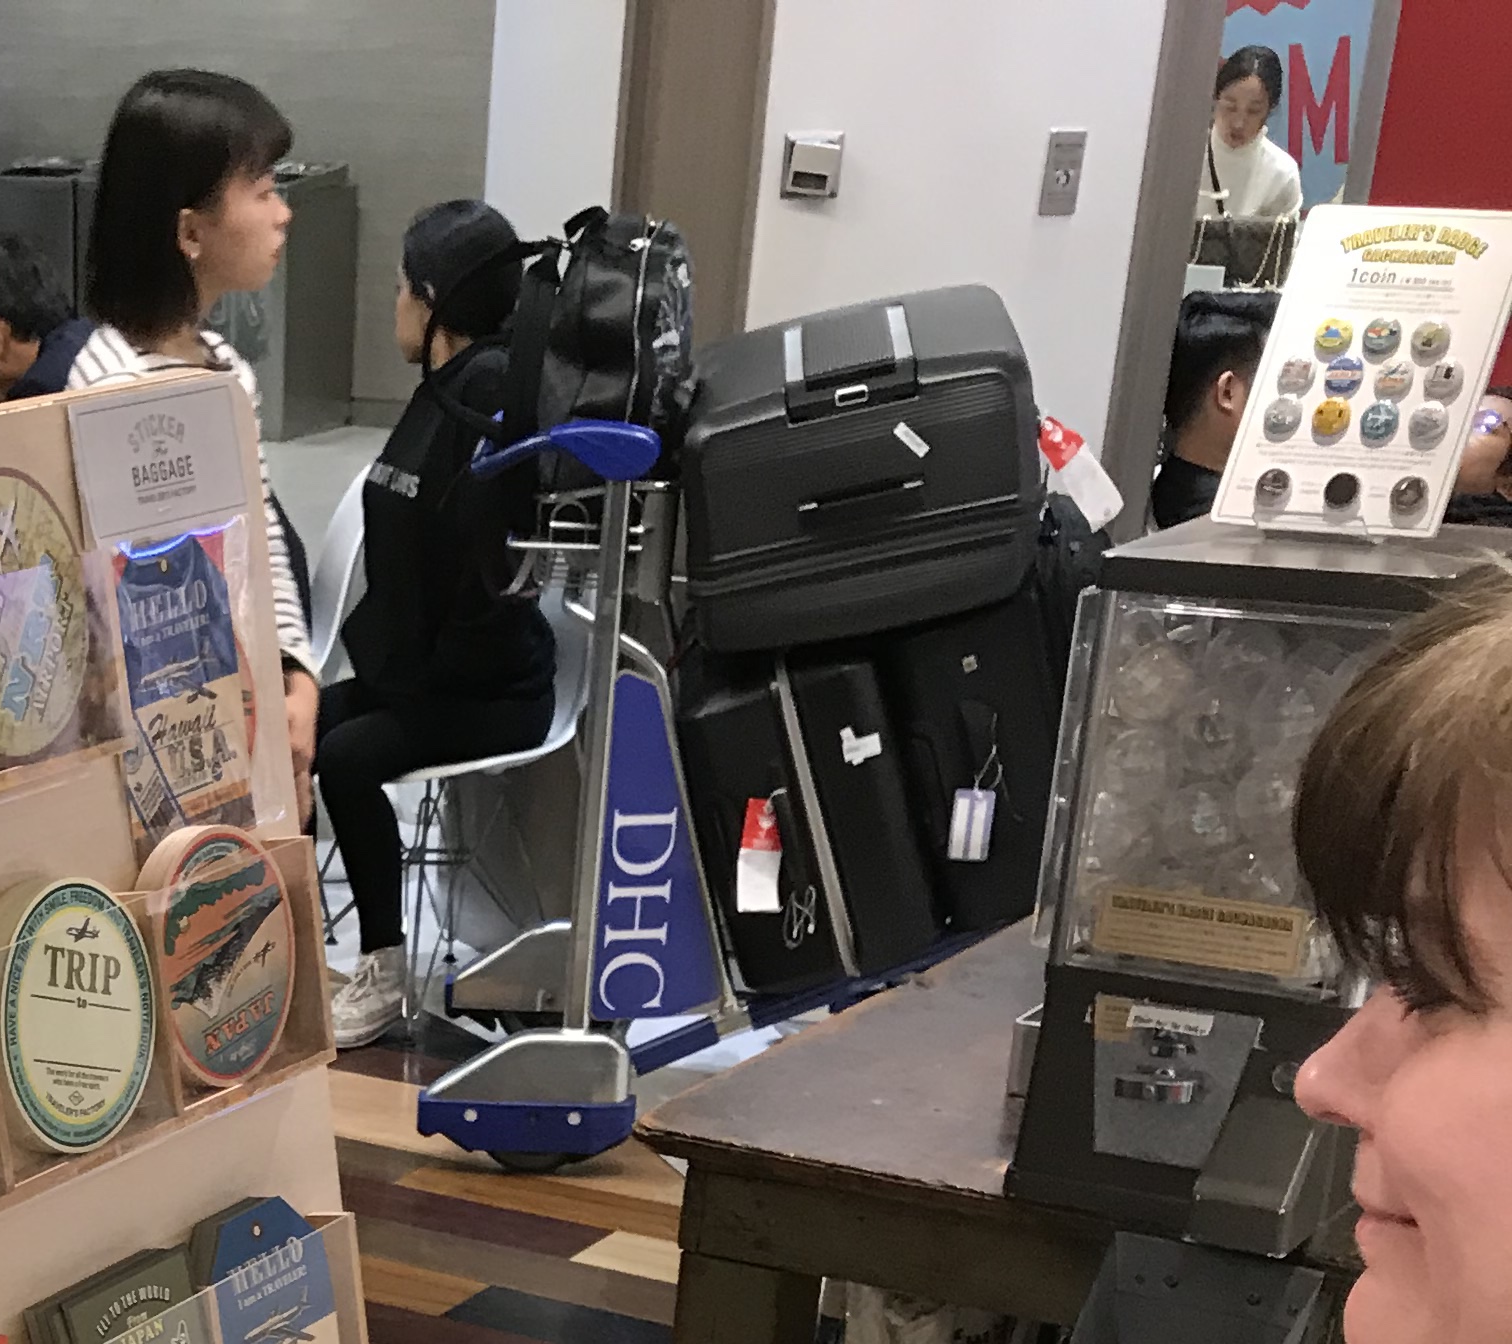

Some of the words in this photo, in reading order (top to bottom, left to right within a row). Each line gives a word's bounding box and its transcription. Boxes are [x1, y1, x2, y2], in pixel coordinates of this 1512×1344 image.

[1341, 223, 1437, 254] TRAVELER'S
[1351, 267, 1397, 284] 1coin
[131, 455, 195, 488] BAGGAGE
[597, 808, 678, 1015] DHC
[44, 943, 122, 996] TRIP
[227, 1236, 305, 1296] HELLO
[120, 1290, 138, 1311] THE
[138, 1285, 171, 1302] WORLD
